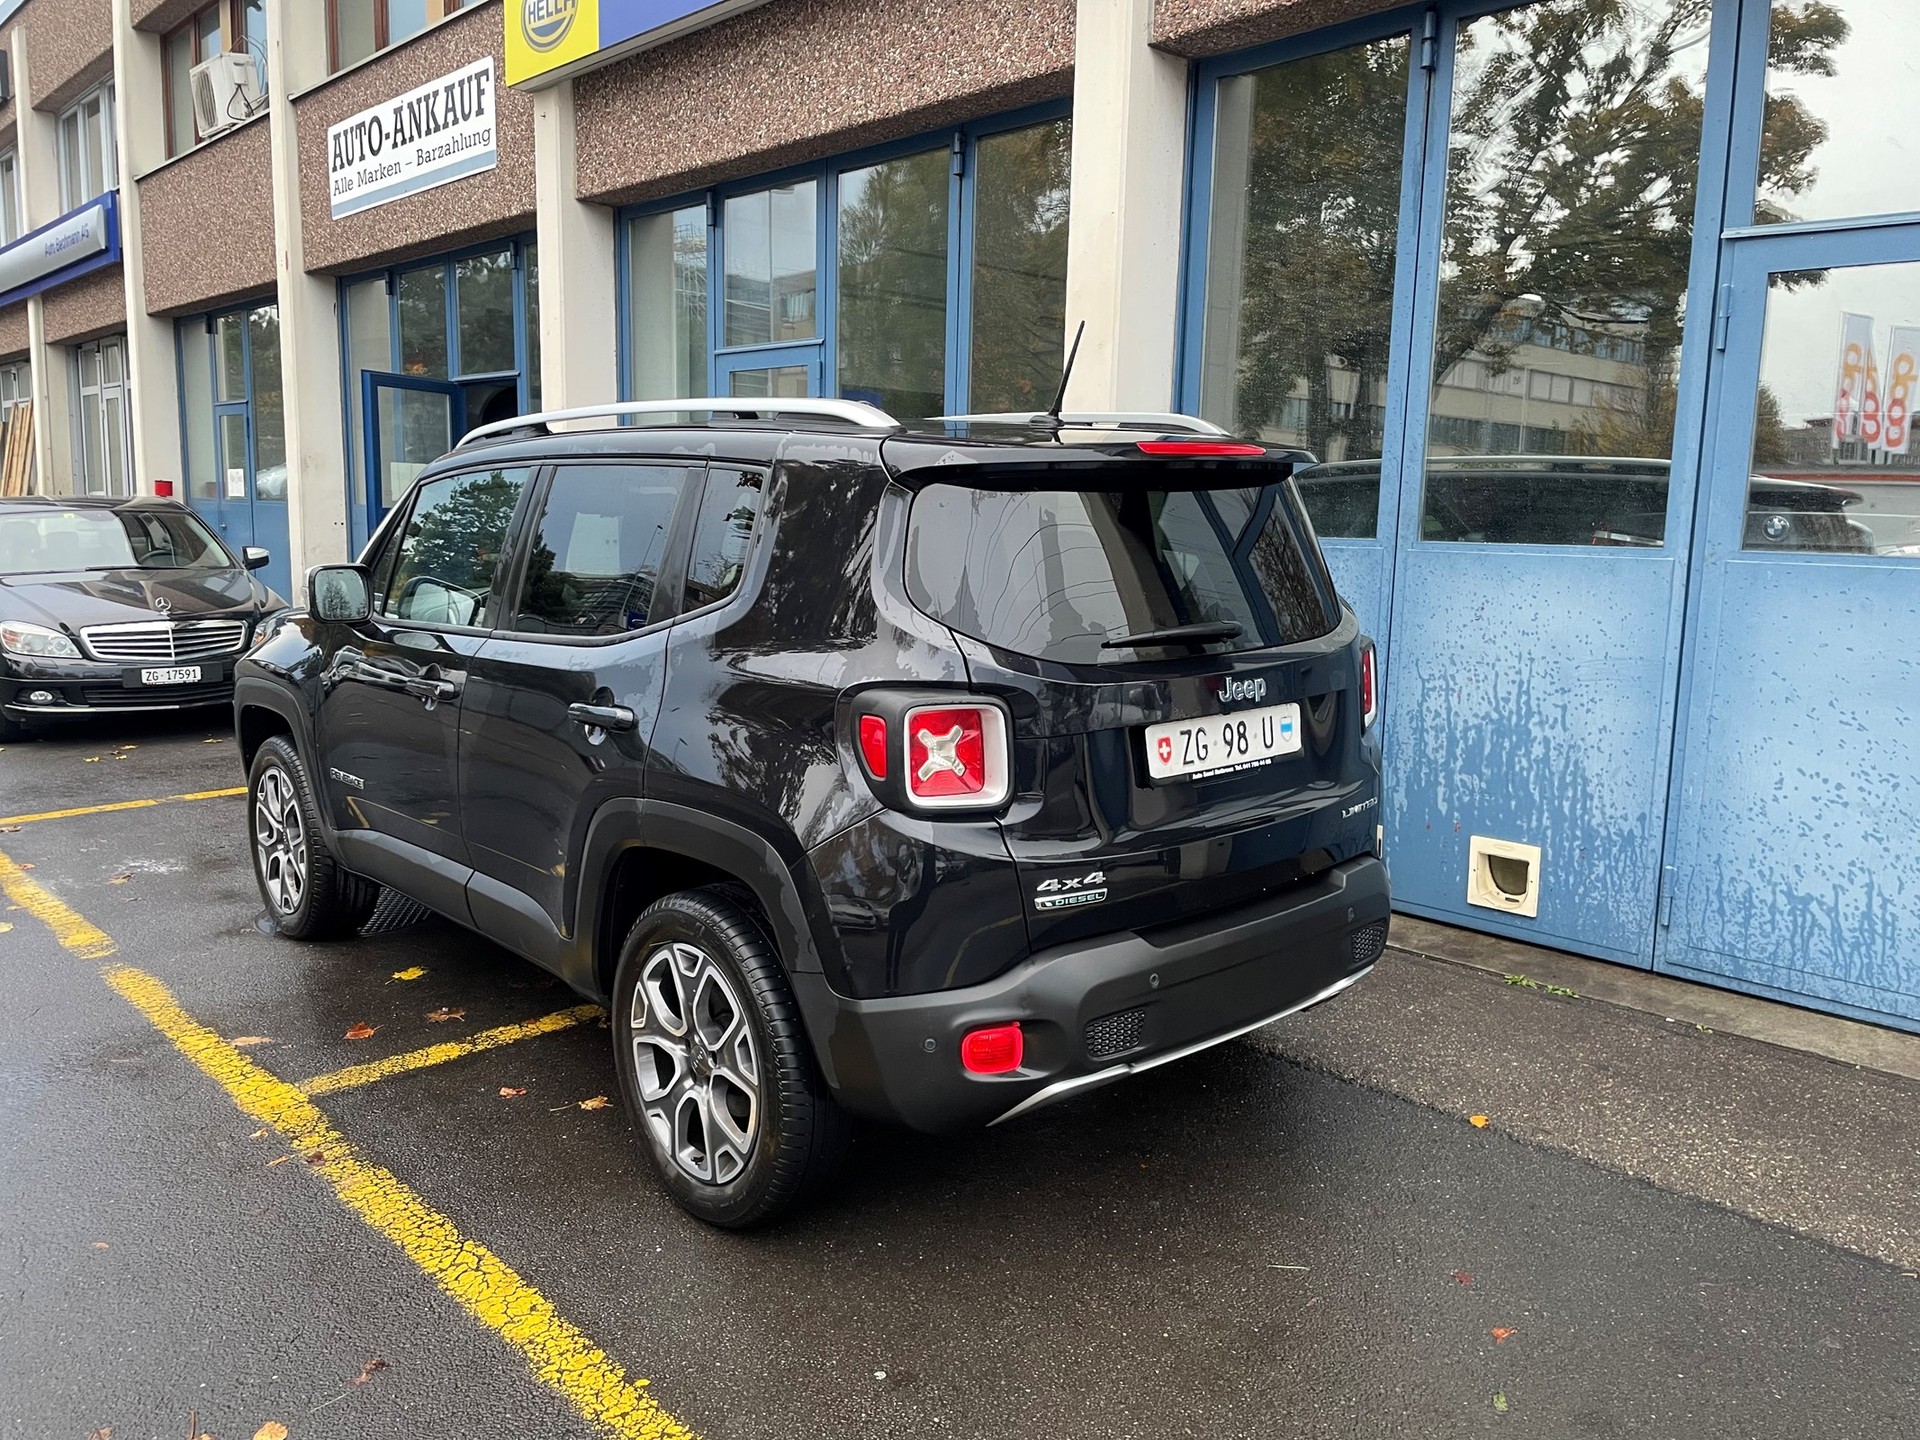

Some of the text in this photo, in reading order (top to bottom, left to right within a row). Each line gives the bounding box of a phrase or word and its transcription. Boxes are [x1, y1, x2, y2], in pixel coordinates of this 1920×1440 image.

[332, 68, 490, 173] AUTO-ANKAUF
[333, 177, 354, 197] Alle
[357, 161, 402, 188] Marken
[416, 128, 491, 167] Barzahlung
[146, 669, 197, 681] ZG 17591
[1218, 676, 1266, 702] Jeep
[1180, 715, 1275, 765] ZG 98 U
[1037, 871, 1106, 892] 4x4
[1055, 893, 1103, 906] DIESEL
